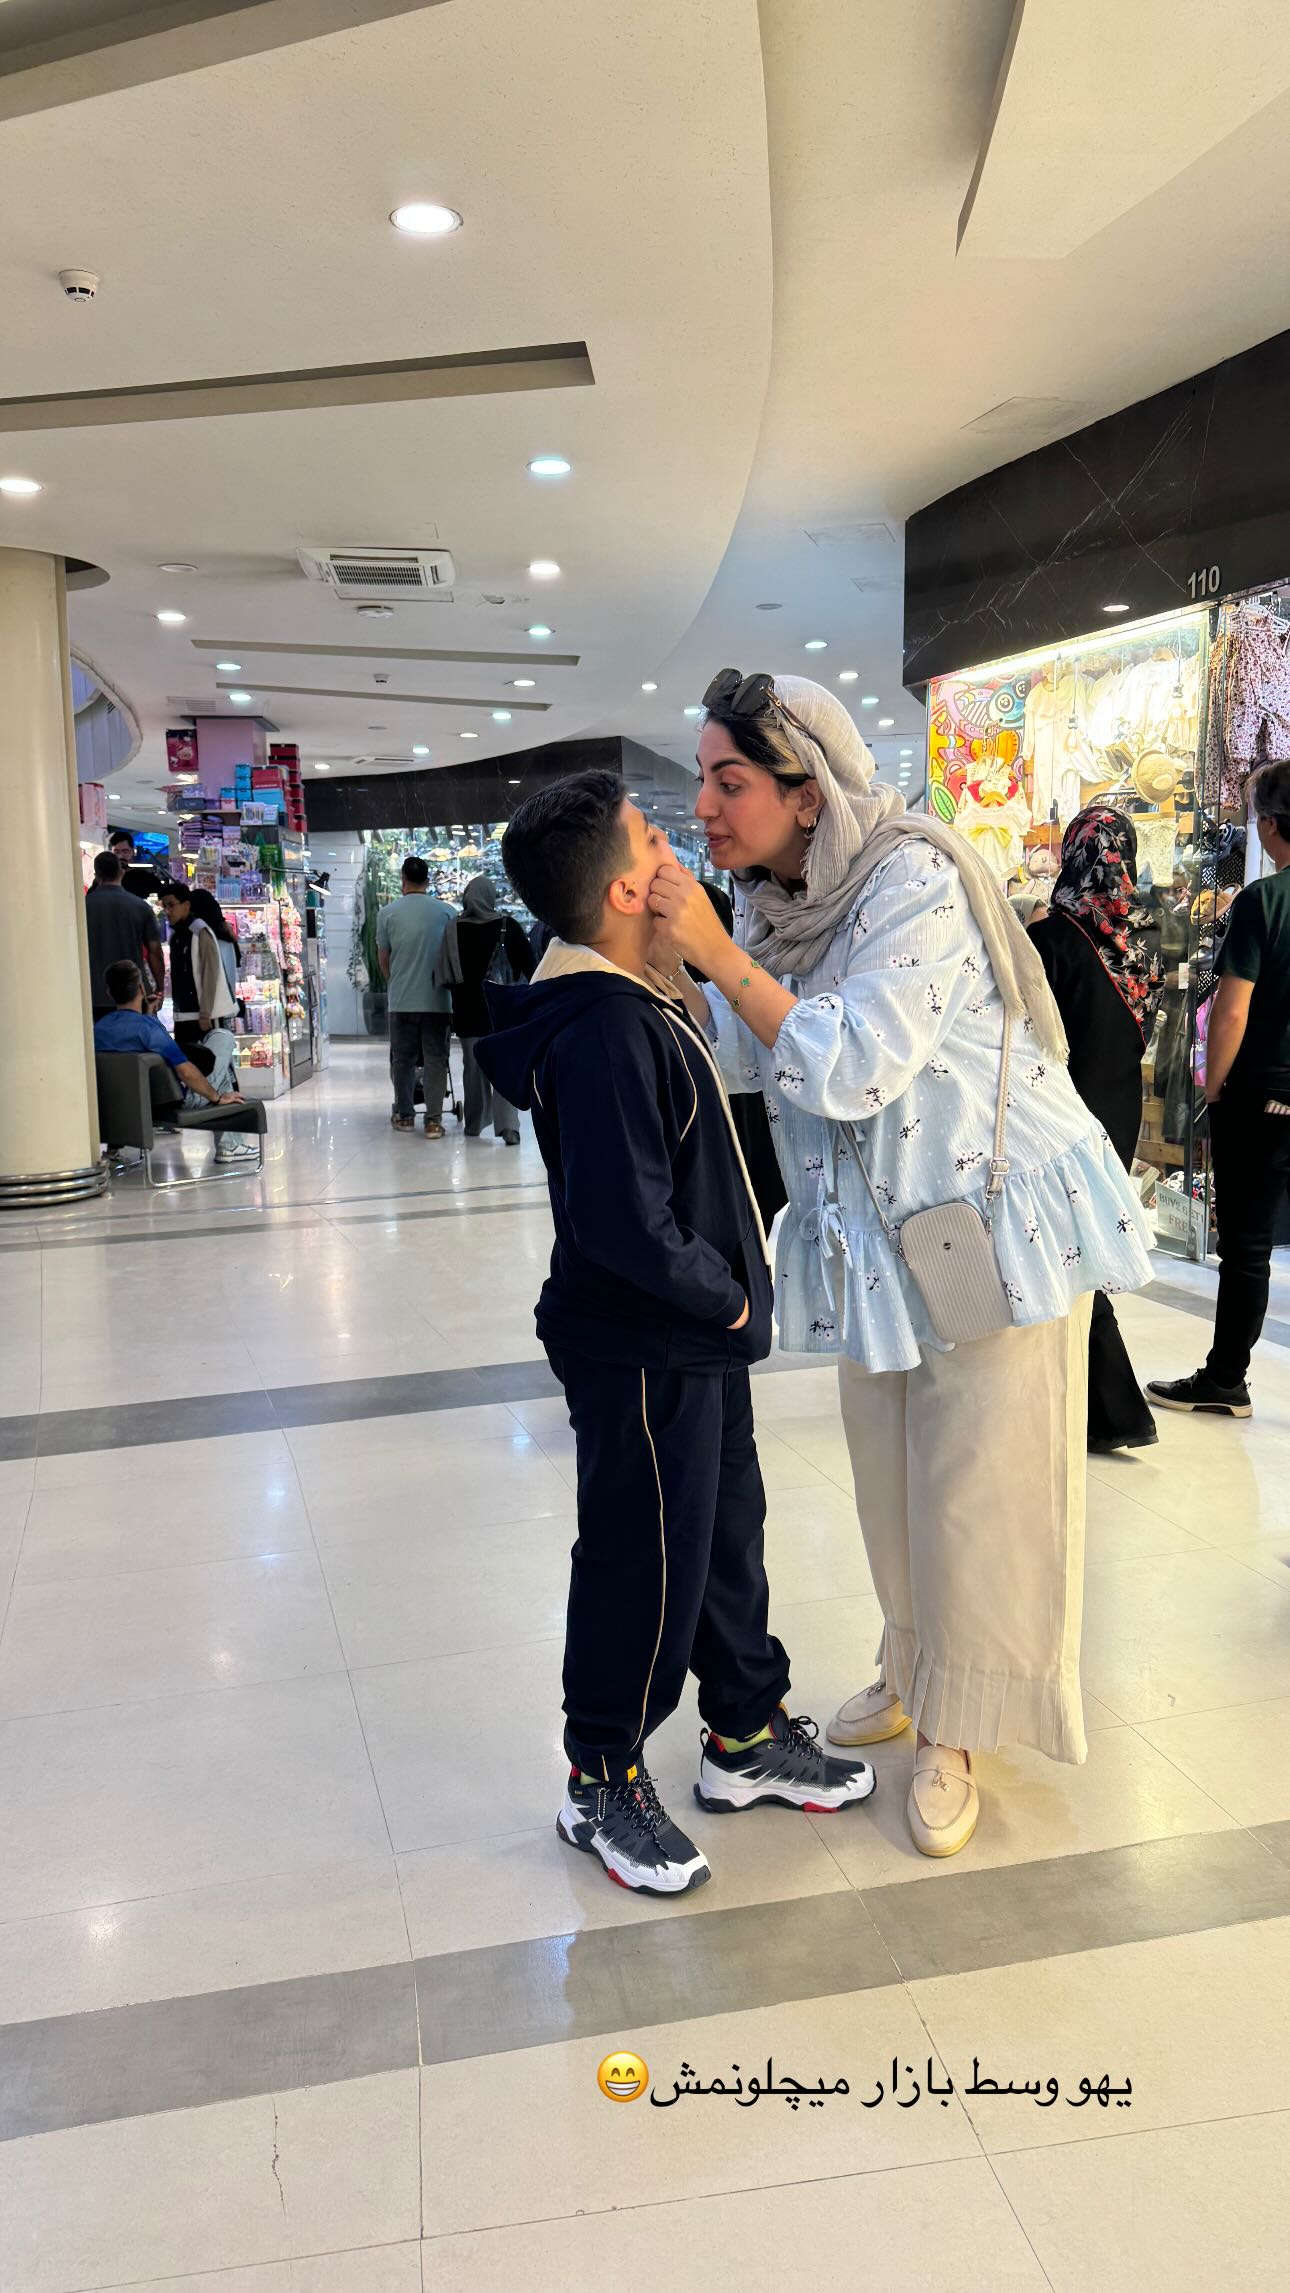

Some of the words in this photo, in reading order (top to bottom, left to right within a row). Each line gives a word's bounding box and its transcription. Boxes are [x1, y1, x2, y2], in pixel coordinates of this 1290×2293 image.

[1187, 565, 1220, 599] 110
[1159, 1193, 1176, 1209] BUY
[1168, 1213, 1189, 1234] FRE
